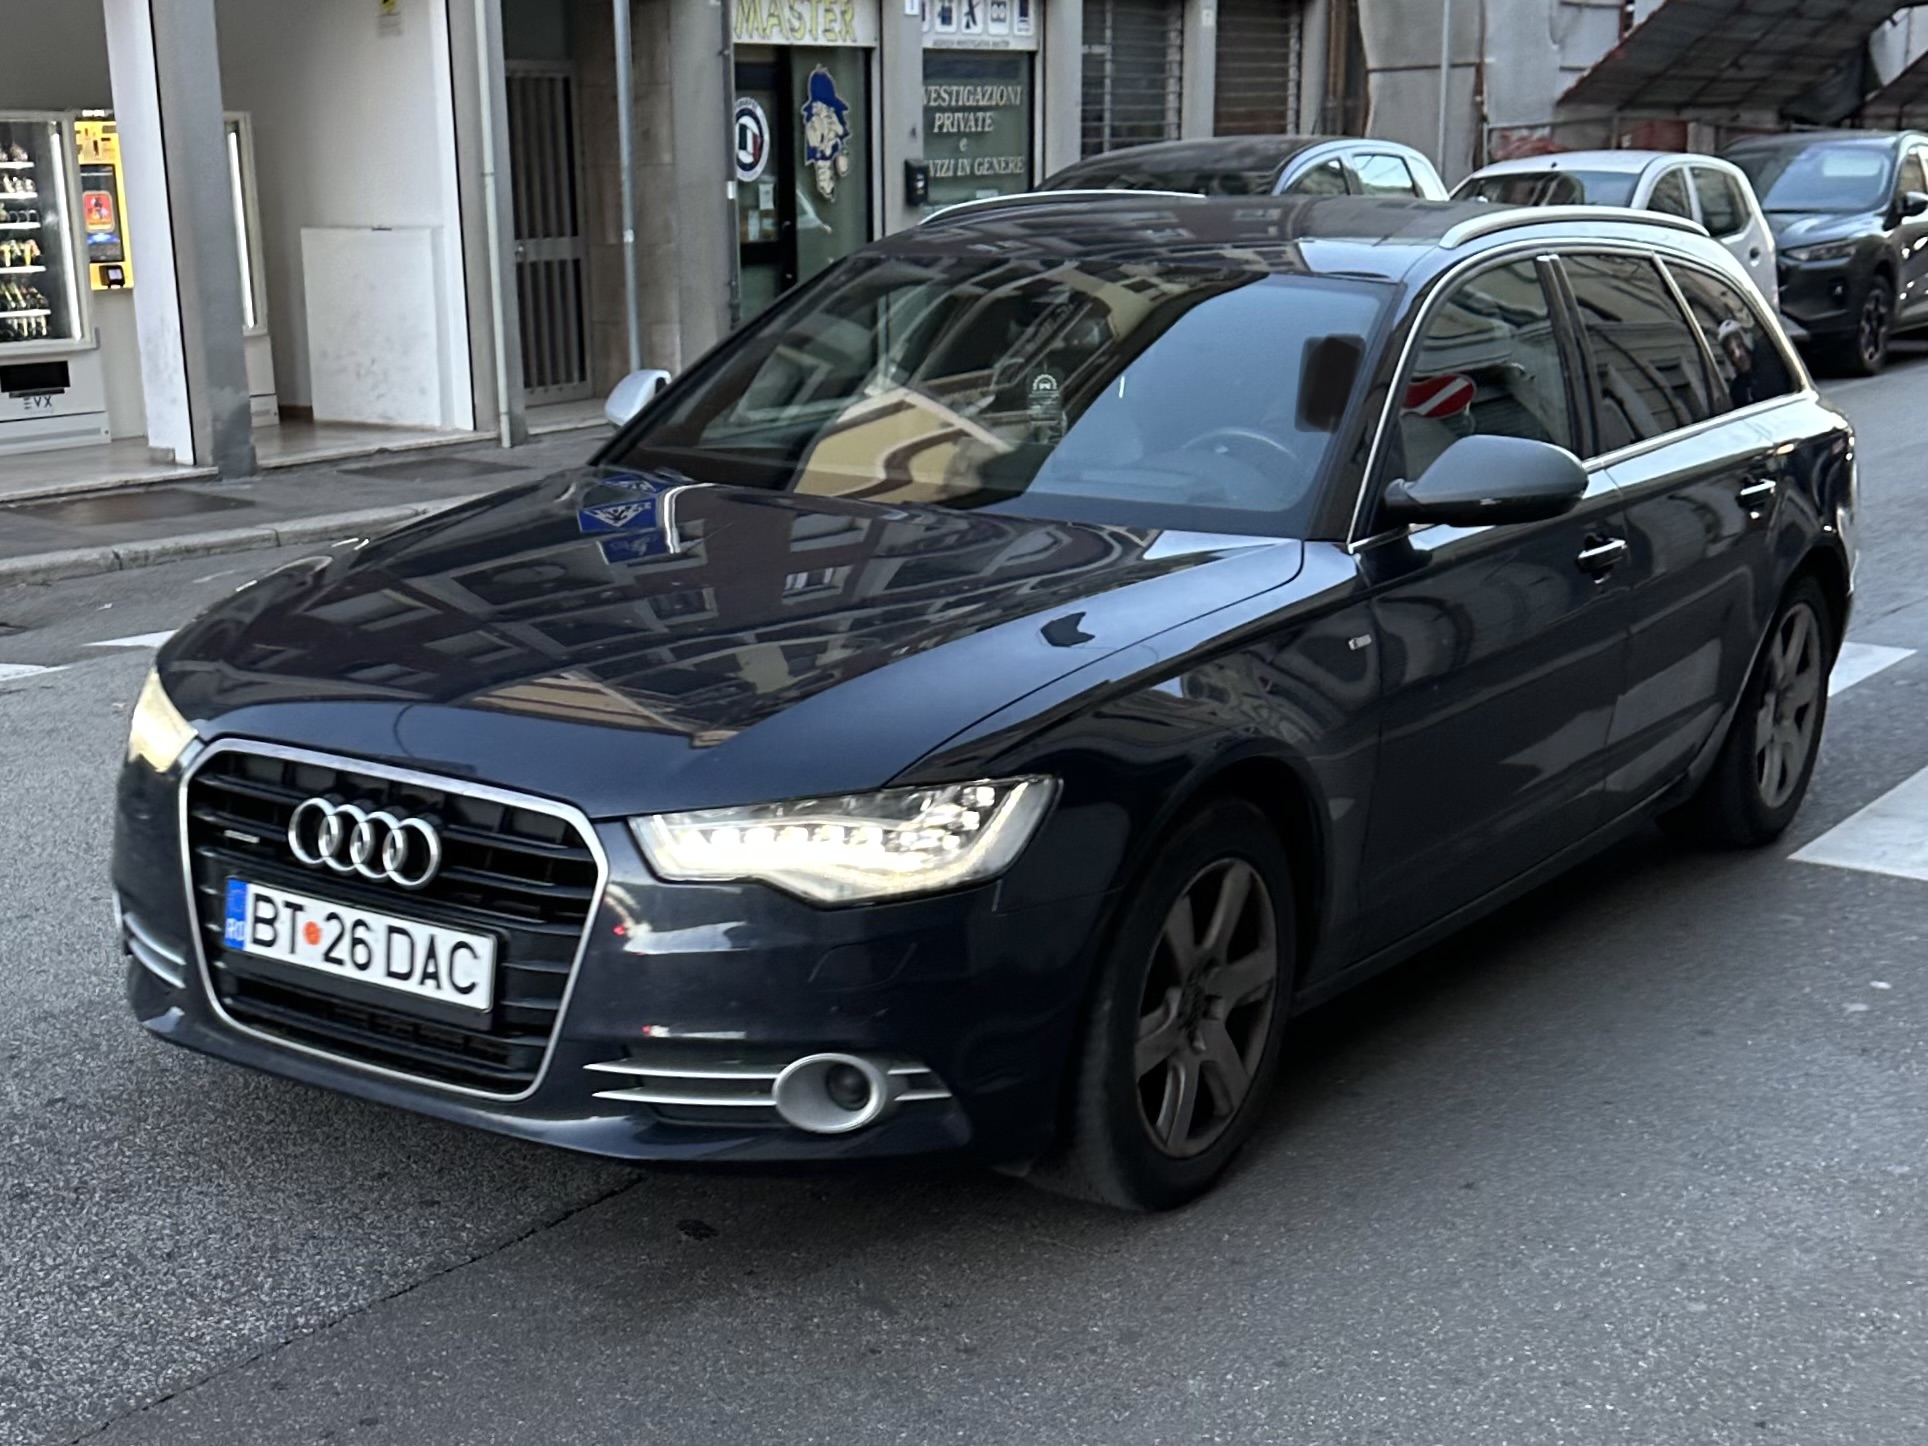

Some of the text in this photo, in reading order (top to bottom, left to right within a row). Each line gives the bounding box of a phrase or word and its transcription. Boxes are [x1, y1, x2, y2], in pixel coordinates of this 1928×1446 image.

[734, 0, 857, 42] MASTER
[922, 85, 1022, 107] VESTIGAZIONI
[933, 111, 995, 133] PRIVATE
[959, 137, 967, 152] e
[927, 156, 1025, 178] VIZI IN GENERE
[251, 892, 480, 995] BT 26 DAC
